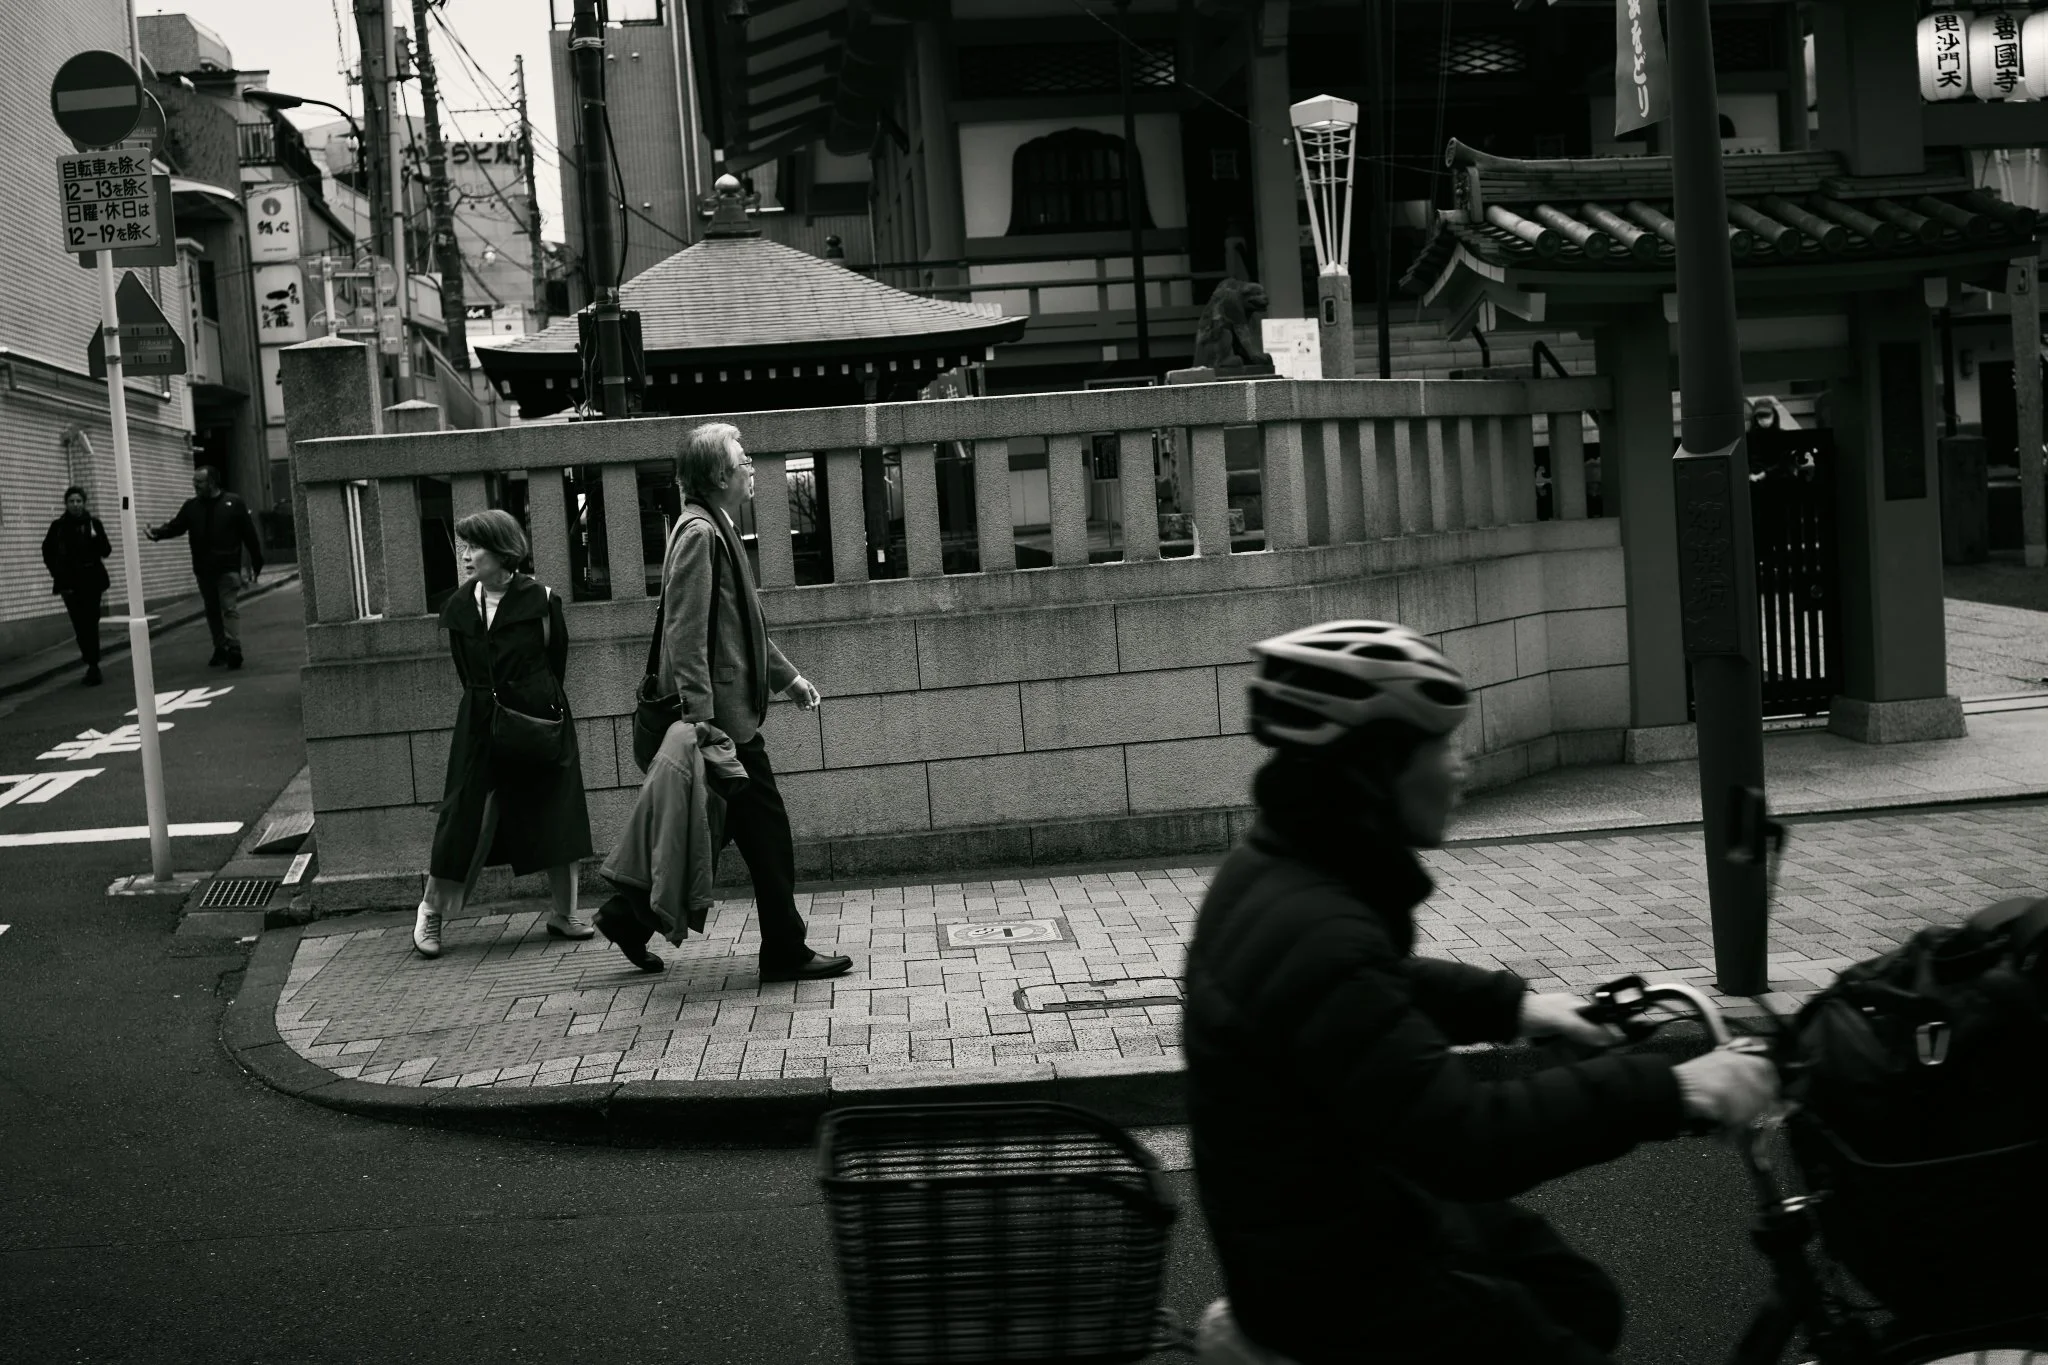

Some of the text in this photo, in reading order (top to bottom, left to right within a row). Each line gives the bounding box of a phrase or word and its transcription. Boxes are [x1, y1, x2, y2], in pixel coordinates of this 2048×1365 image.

[1935, 14, 1962, 88] 毘沙門天
[1992, 14, 2018, 93] 善國寺
[63, 156, 146, 180] 自転車を除く
[67, 200, 150, 224] 日曜・休日は
